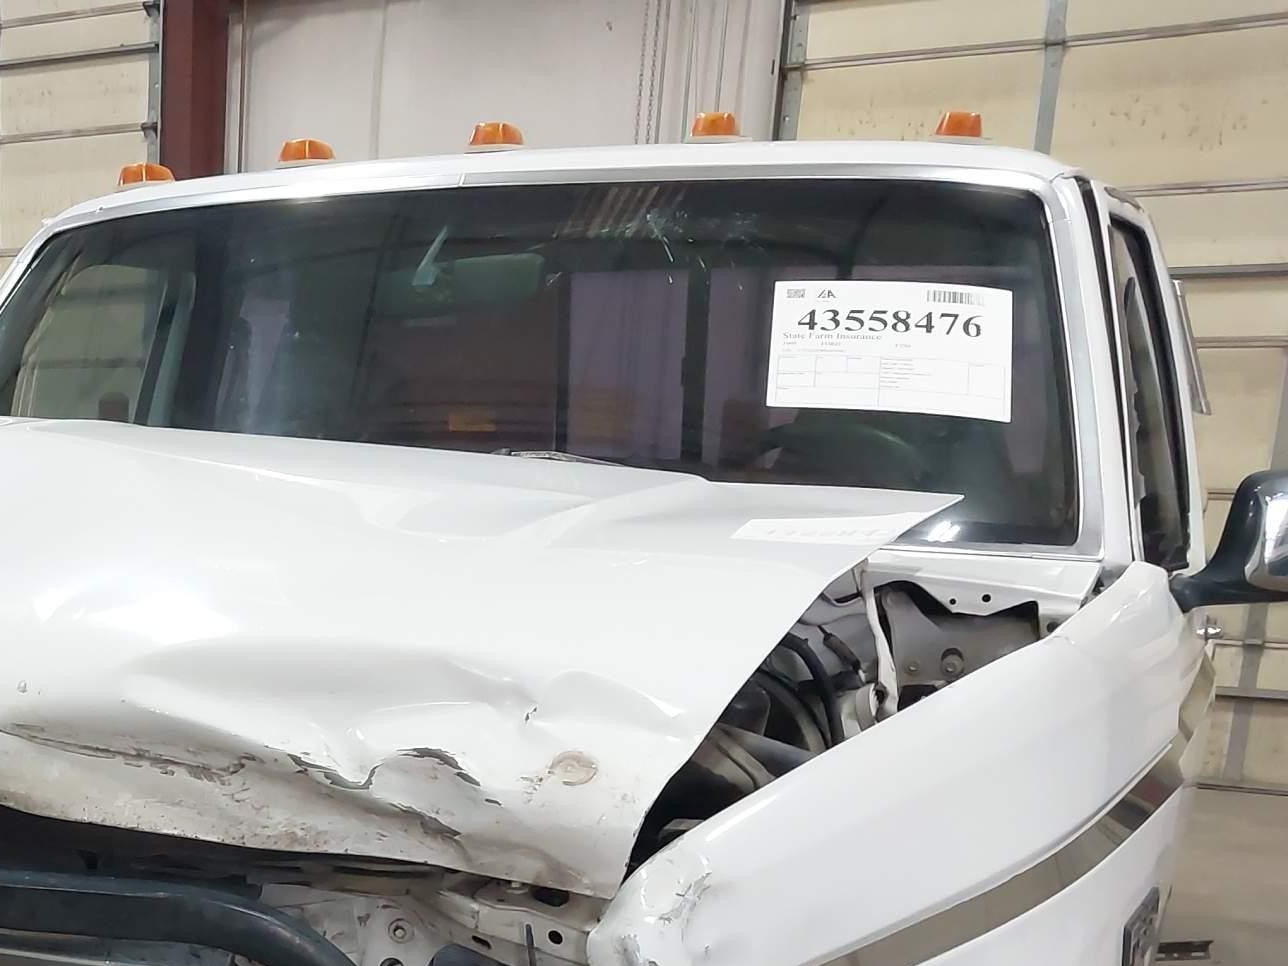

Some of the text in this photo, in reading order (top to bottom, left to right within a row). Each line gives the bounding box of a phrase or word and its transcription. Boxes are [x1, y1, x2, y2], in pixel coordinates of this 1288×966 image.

[797, 309, 984, 337] 43558476
[783, 332, 882, 341] State Farm Insurance
